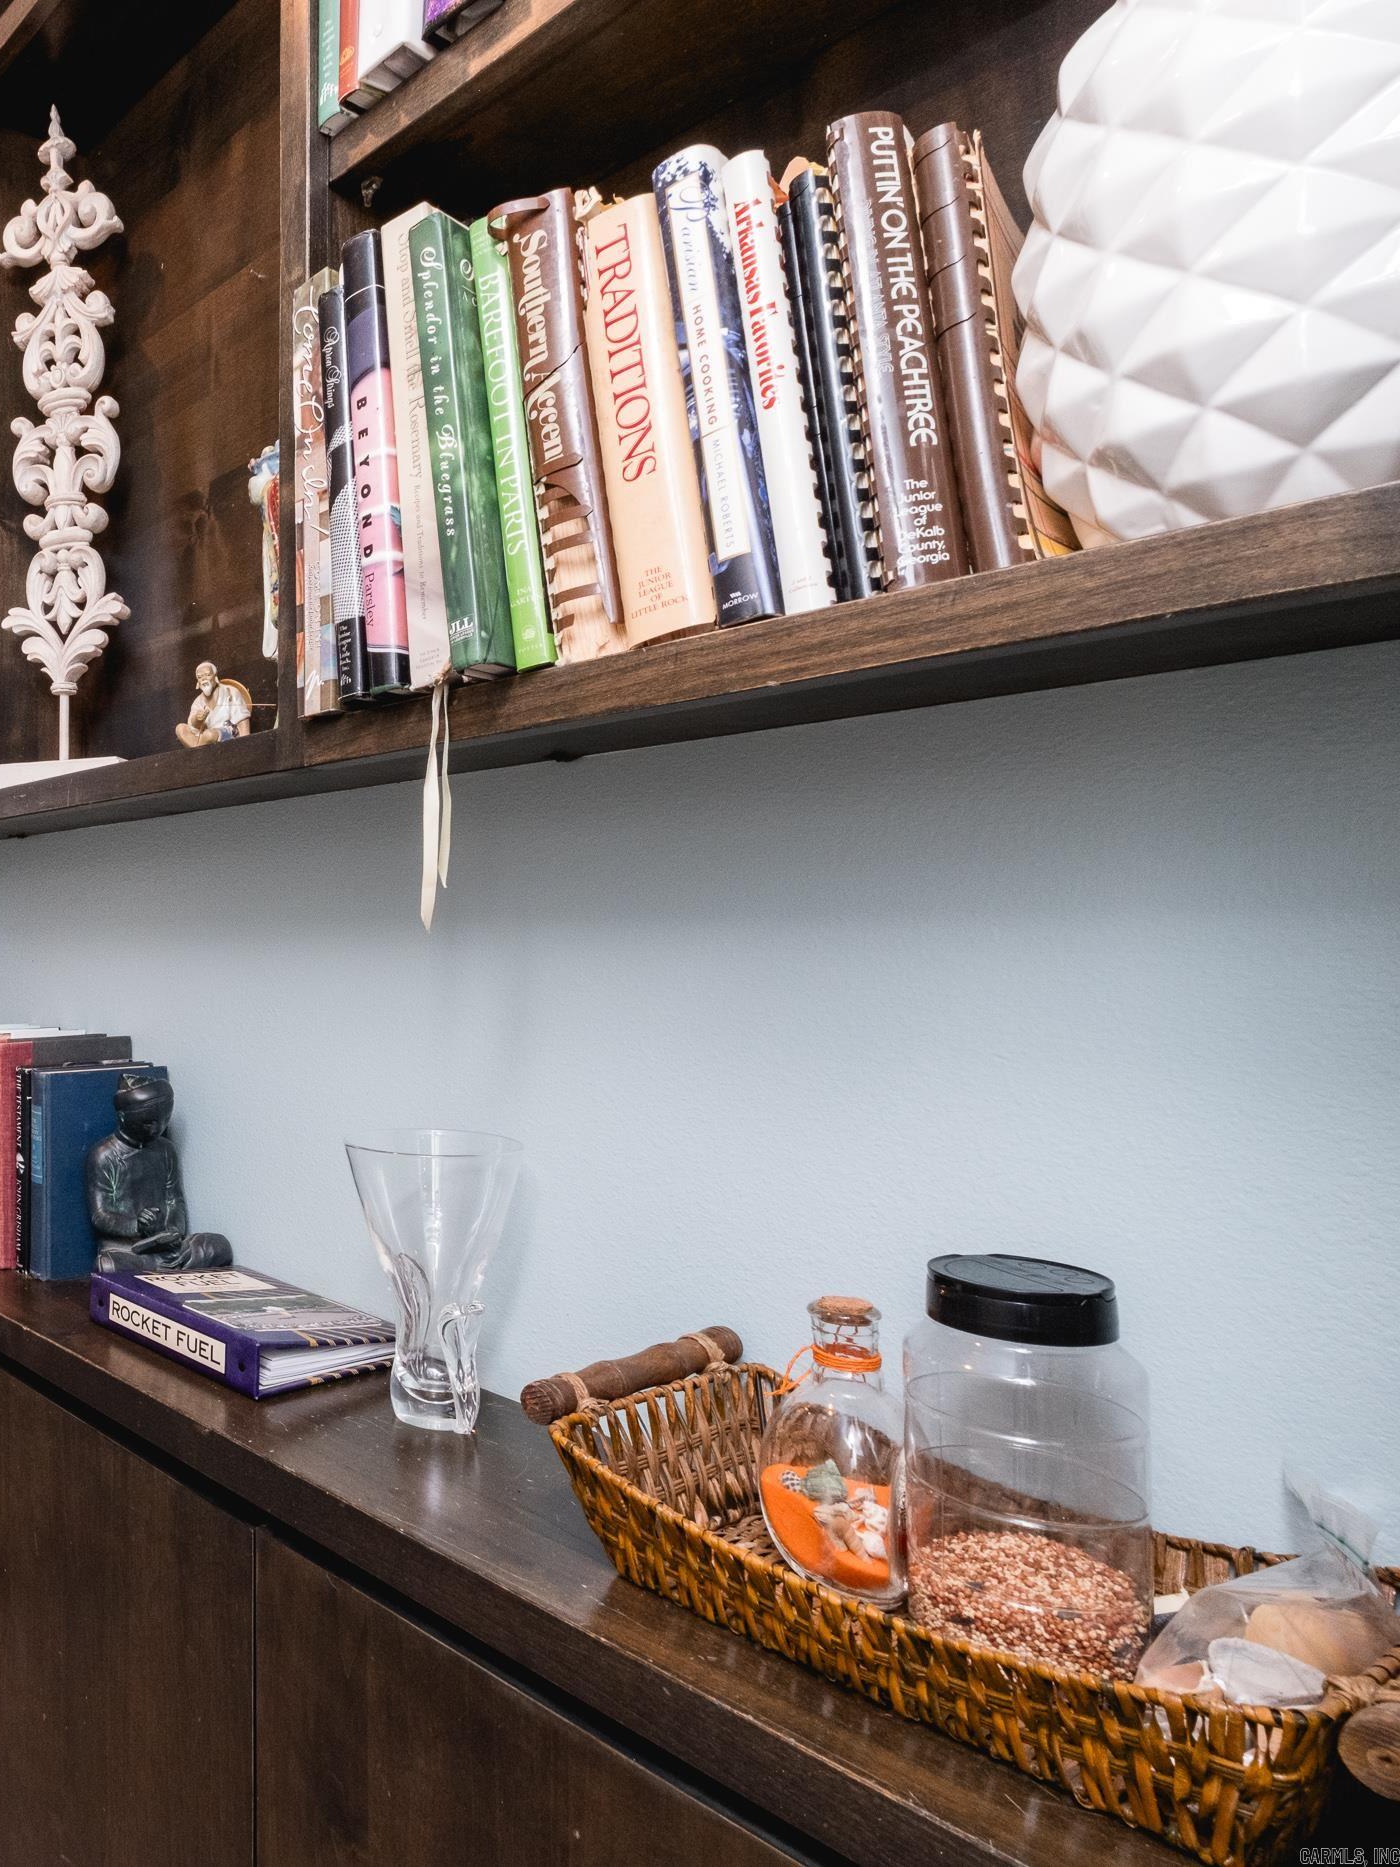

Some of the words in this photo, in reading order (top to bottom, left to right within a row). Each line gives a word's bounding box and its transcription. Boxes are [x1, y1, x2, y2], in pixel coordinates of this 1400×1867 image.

[868, 126, 905, 208] PUTTIN'
[733, 197, 764, 306] Arkansas
[881, 208, 911, 250] ON
[417, 246, 444, 345] Splendor
[886, 252, 918, 300] THE
[513, 228, 552, 383] Southern
[692, 303, 707, 348] HOME
[430, 353, 443, 376] in
[478, 266, 514, 425] BAREFOOT
[595, 223, 657, 482] TRADITIONS
[748, 299, 786, 411] Favorites
[325, 365, 343, 409] Strings
[699, 353, 718, 426] COOKING
[893, 303, 938, 448] PEACHTREE
[432, 384, 450, 416] the
[523, 371, 564, 466] Accen
[407, 394, 426, 480] Rosemary
[495, 432, 515, 470] IN
[356, 396, 375, 559] BEYOND
[435, 423, 458, 537] Bluegrass
[712, 439, 727, 493] MICHAEL
[720, 494, 736, 549] ROBERTS
[899, 490, 937, 504] Junior
[903, 479, 929, 490] The
[500, 473, 529, 557] PARIS
[913, 515, 928, 527] of
[638, 571, 672, 590] JUNIOR
[645, 565, 663, 577] THE
[896, 550, 950, 566] Georgia
[364, 572, 377, 628] Parsley
[631, 602, 658, 620] LITTLE
[638, 580, 674, 599] LEAGUE
[649, 593, 663, 603] OF
[721, 591, 760, 610] MORROW
[449, 616, 474, 635] JLL
[144, 1271, 238, 1283] ROCKET
[175, 1278, 242, 1288] FUEL
[111, 1299, 171, 1342] ROCKET
[176, 1330, 221, 1366] FUEL
